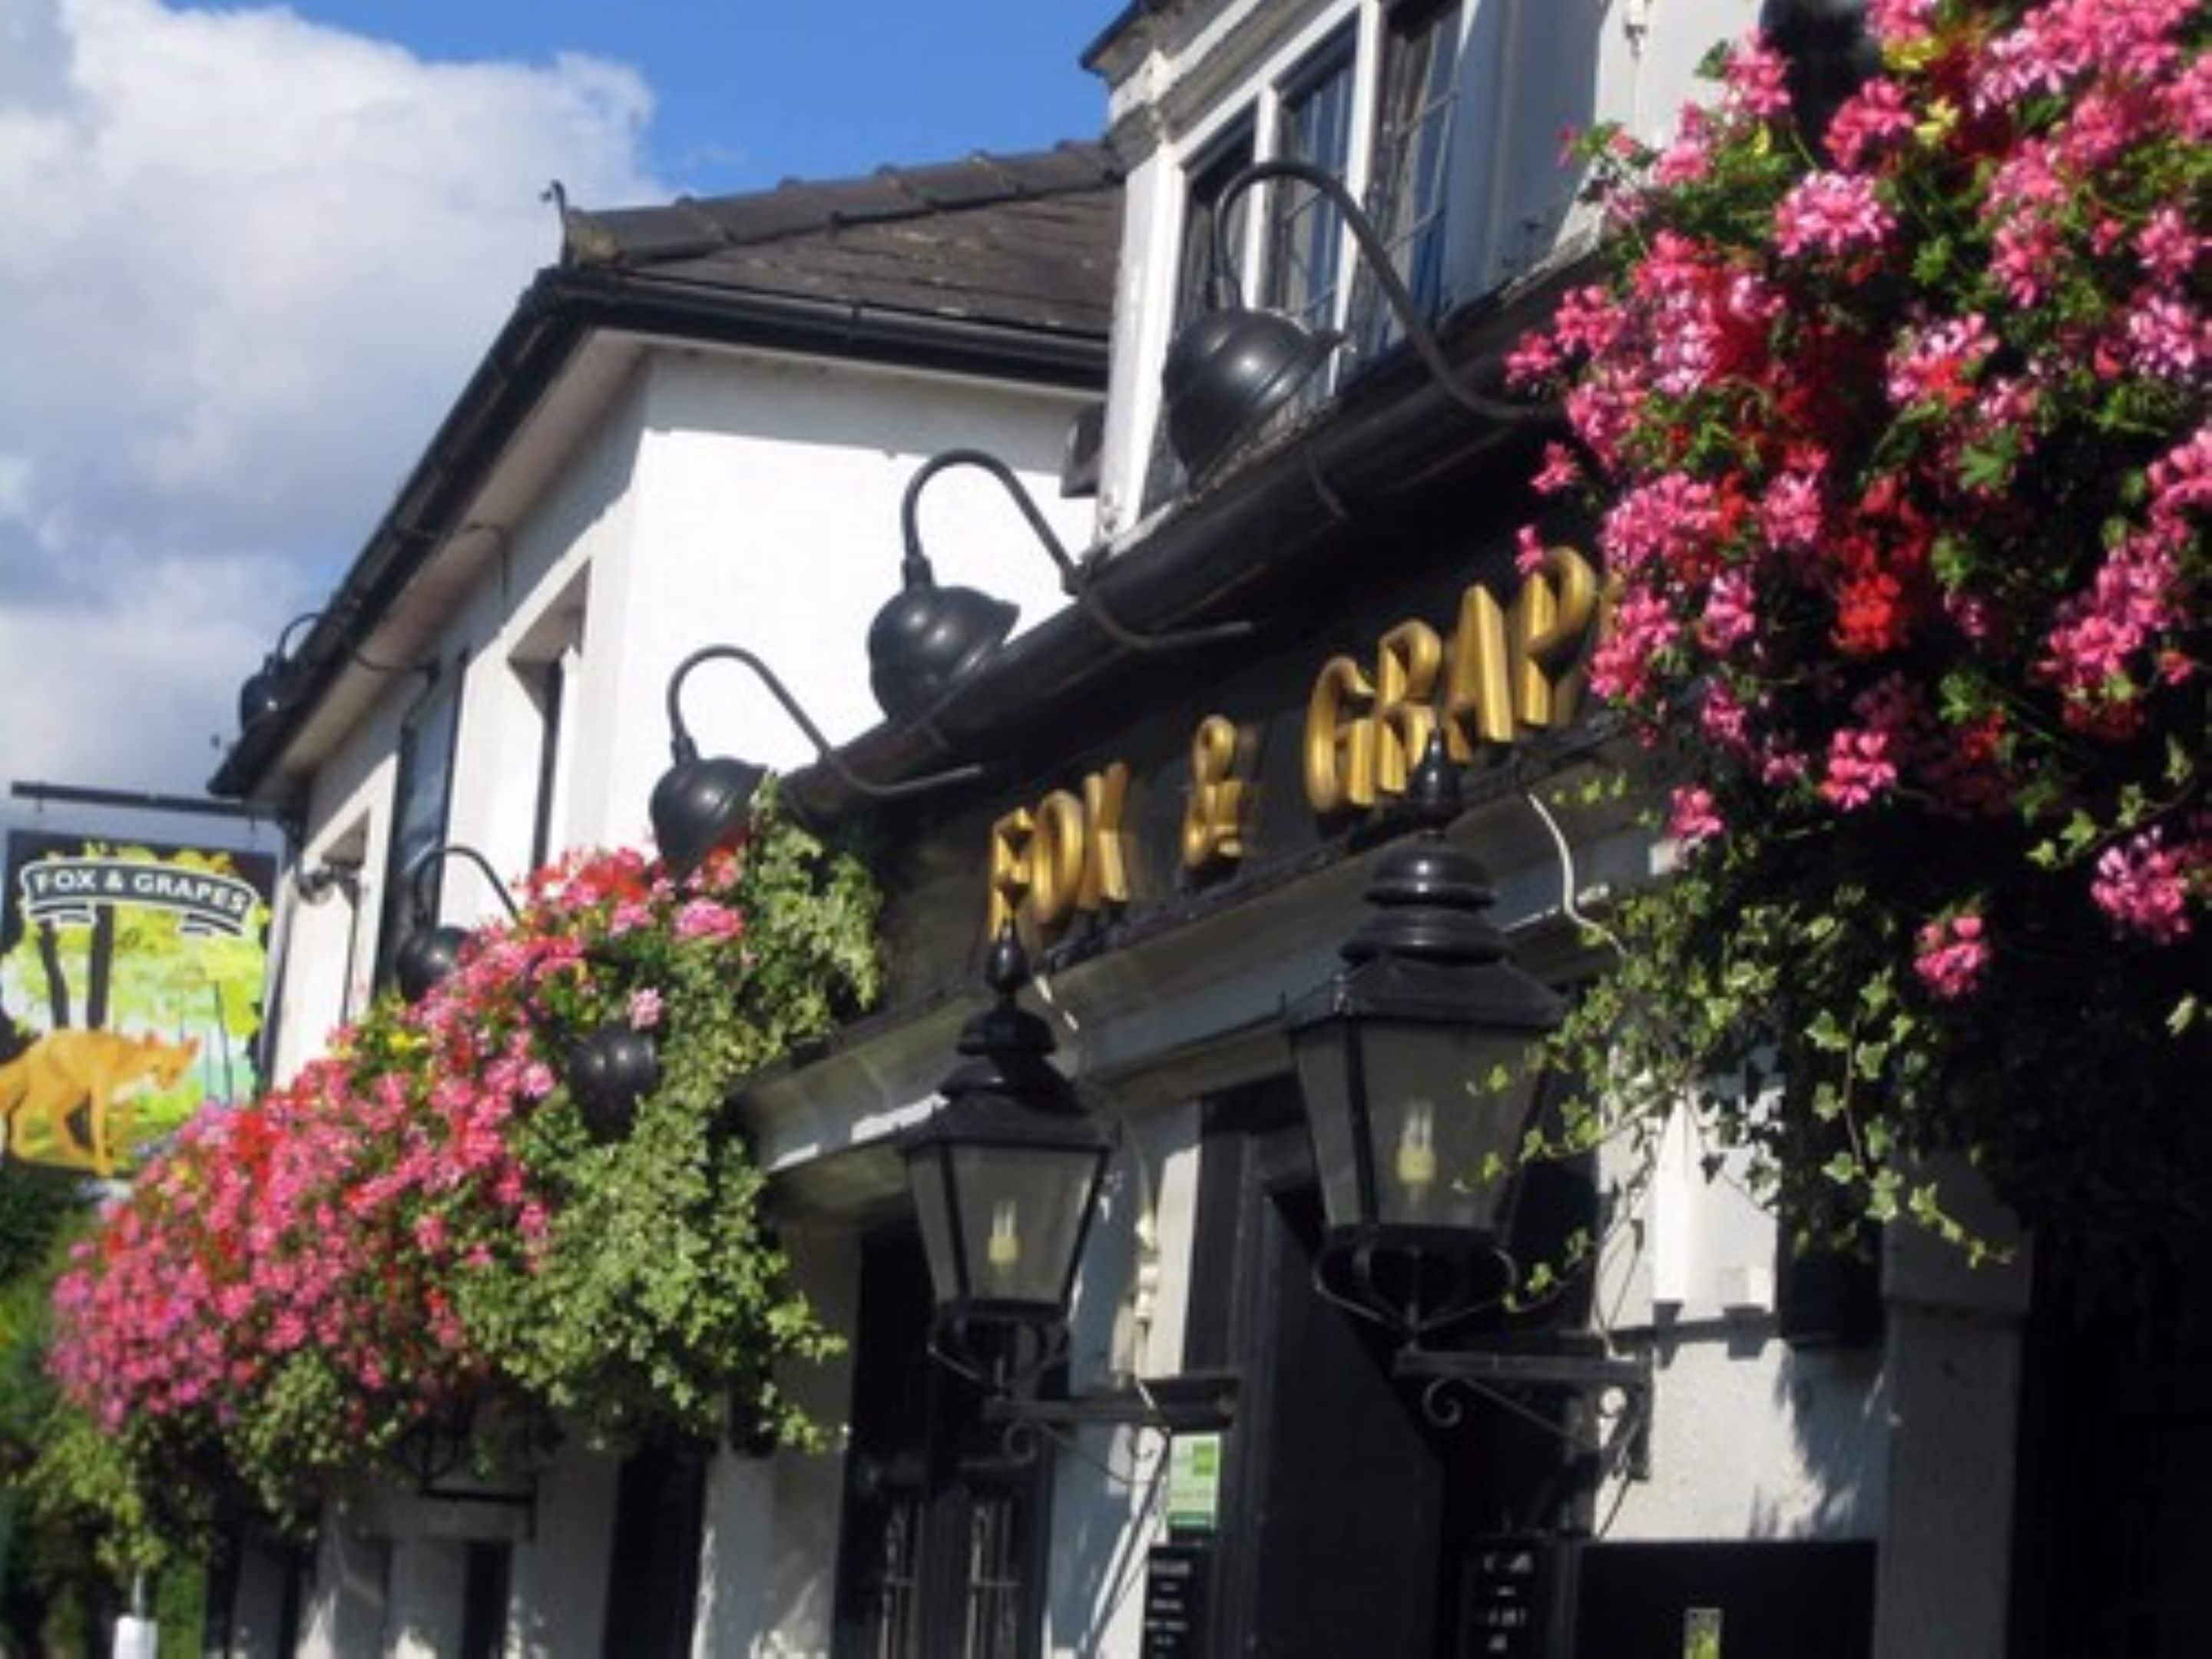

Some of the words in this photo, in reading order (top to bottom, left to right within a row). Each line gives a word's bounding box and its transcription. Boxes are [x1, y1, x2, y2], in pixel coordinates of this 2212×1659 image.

[989, 763, 1128, 942] FOX
[1183, 714, 1244, 869] &
[1303, 546, 1619, 812] GRAP
[35, 869, 95, 893] FOX
[103, 871, 124, 891] &
[134, 873, 247, 913] GRAPES
